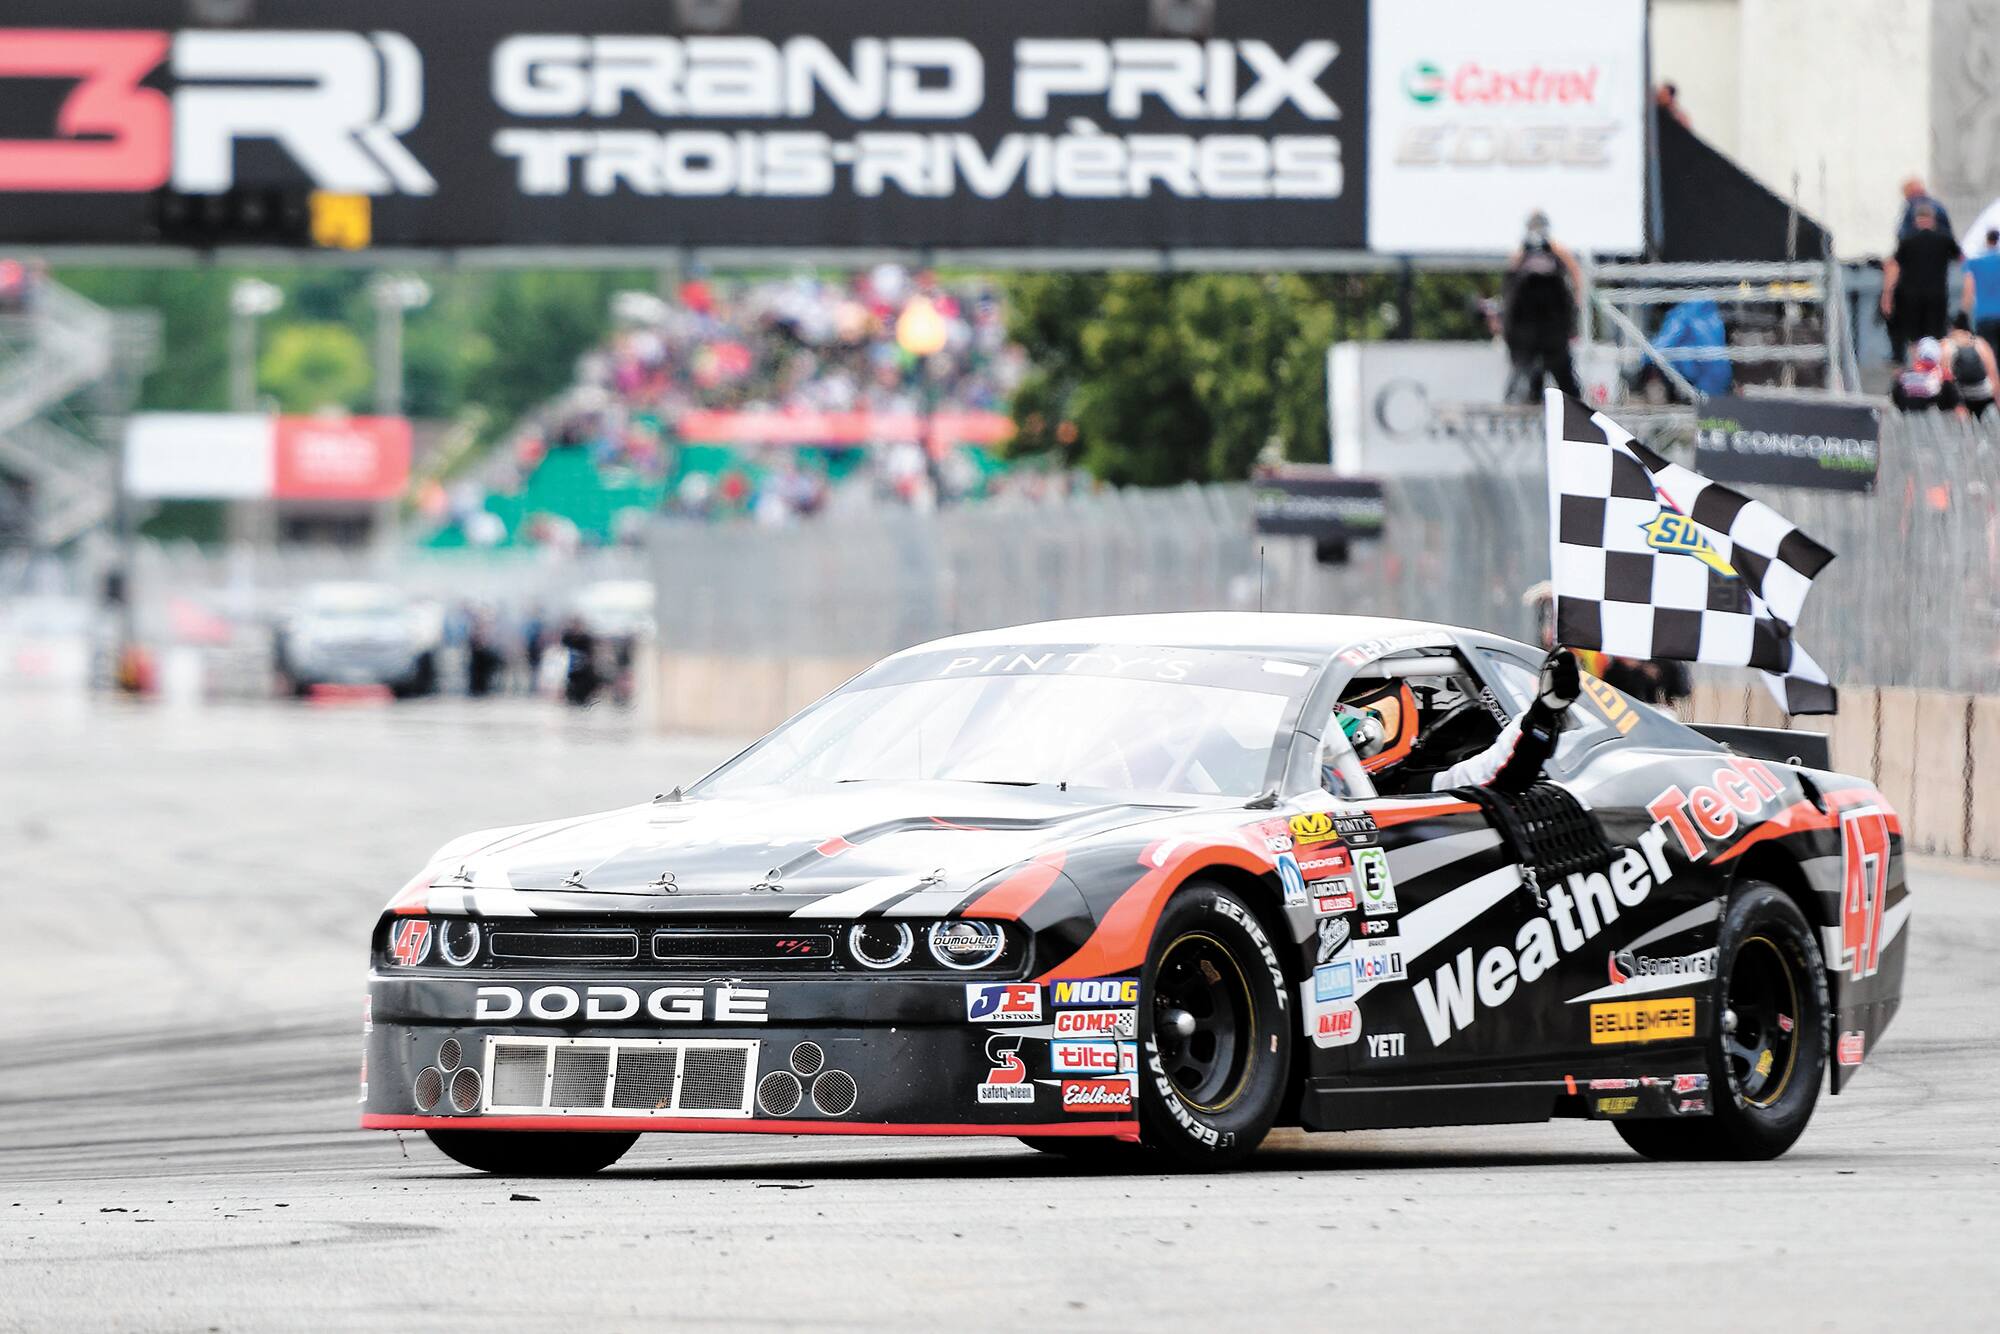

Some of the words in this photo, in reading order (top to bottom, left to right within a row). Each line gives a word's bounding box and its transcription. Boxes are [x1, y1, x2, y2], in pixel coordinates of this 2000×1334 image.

[1012, 37, 1342, 120] PRIX
[1453, 62, 1599, 104] Castrol
[1731, 430, 1880, 461] CONCORDE
[937, 653, 1193, 681] PINTY'S
[1334, 818, 1377, 832] PINTY'S
[1299, 856, 1344, 870] DODGE
[1312, 881, 1348, 898] LINCOLN
[1412, 757, 1786, 1048] WeatherTech
[1842, 807, 1891, 982] 47
[394, 919, 431, 967] 47
[932, 935, 999, 946] DUMOULIN
[1215, 896, 1290, 1010] GENERAL
[1355, 954, 1389, 978] Mobil
[1391, 952, 1402, 974] 1
[475, 985, 770, 1023] DODGE
[970, 985, 1036, 1019] JE
[1055, 981, 1138, 1003] MOOG
[1058, 1013, 1118, 1032] COMP
[1594, 1008, 1691, 1033] BELLEMARE
[1367, 1033, 1406, 1058] YETI
[982, 1086, 1032, 1101] safety-kleen
[1063, 1085, 1132, 1105] Edelbrock
[1145, 1032, 1219, 1147] GENERAL
